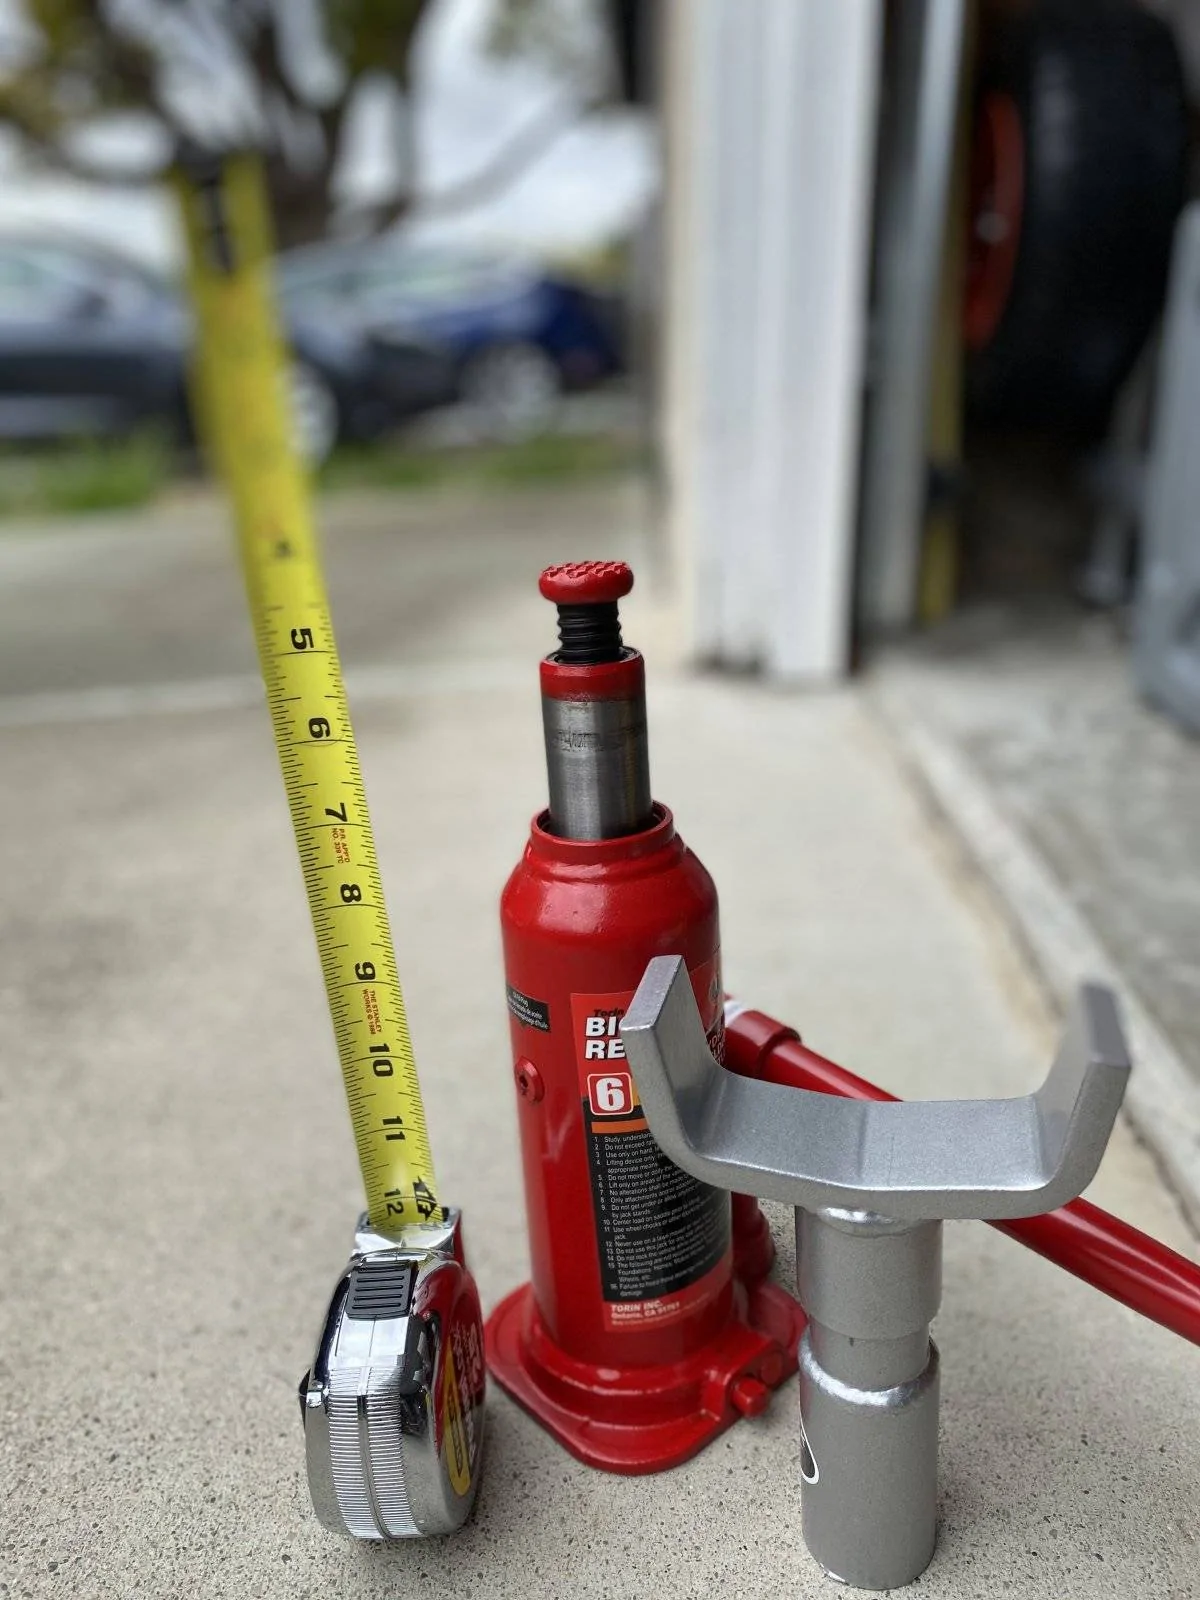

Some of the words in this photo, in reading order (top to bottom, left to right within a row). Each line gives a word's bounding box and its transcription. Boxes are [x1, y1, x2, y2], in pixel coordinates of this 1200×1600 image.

[291, 628, 315, 650] 5
[308, 717, 331, 739] 6
[325, 802, 347, 822] 7
[340, 883, 362, 903] 8
[355, 961, 376, 981] 9
[585, 1016, 617, 1037] BI
[585, 1038, 626, 1059] RE
[369, 1043, 394, 1077] 10
[595, 1077, 625, 1112] 6
[382, 1115, 406, 1141] 11
[384, 1188, 404, 1215] 12
